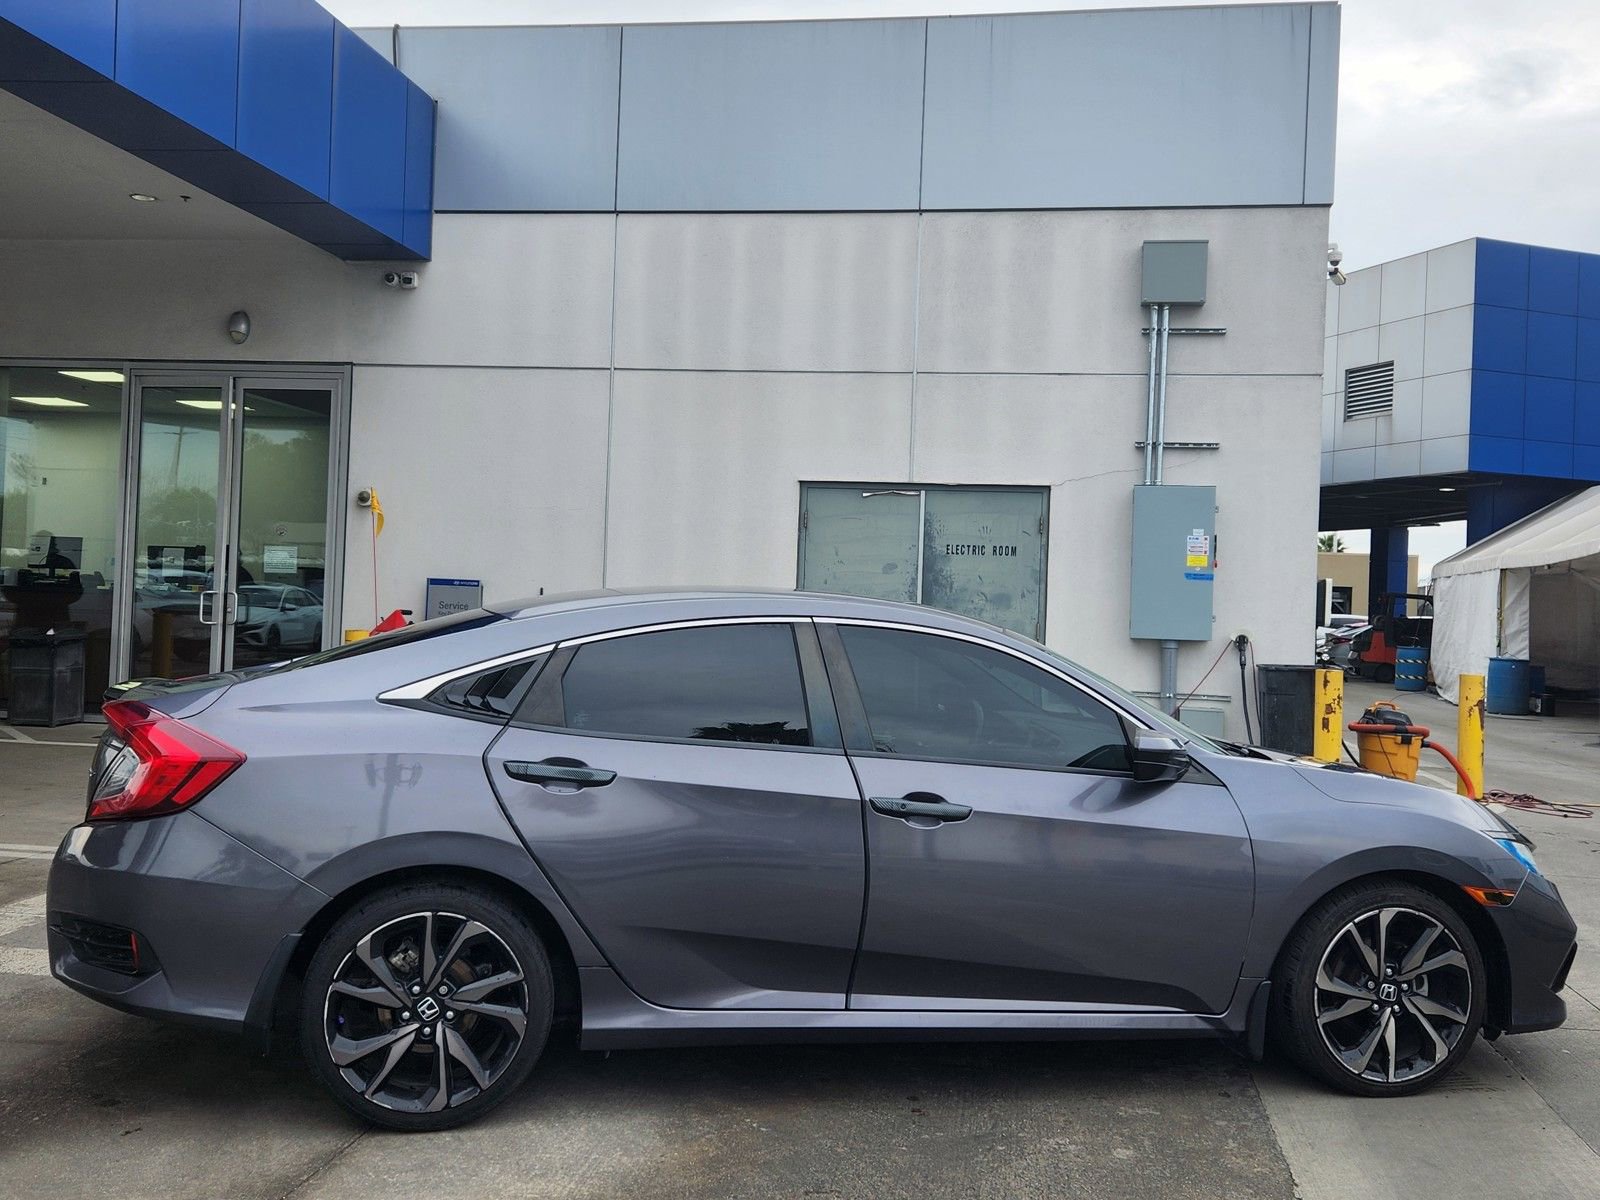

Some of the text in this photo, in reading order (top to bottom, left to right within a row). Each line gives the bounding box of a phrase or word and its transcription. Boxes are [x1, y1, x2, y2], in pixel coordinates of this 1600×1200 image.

[946, 544, 1017, 557] ELECTRIC ROOM
[439, 601, 469, 611] Service
